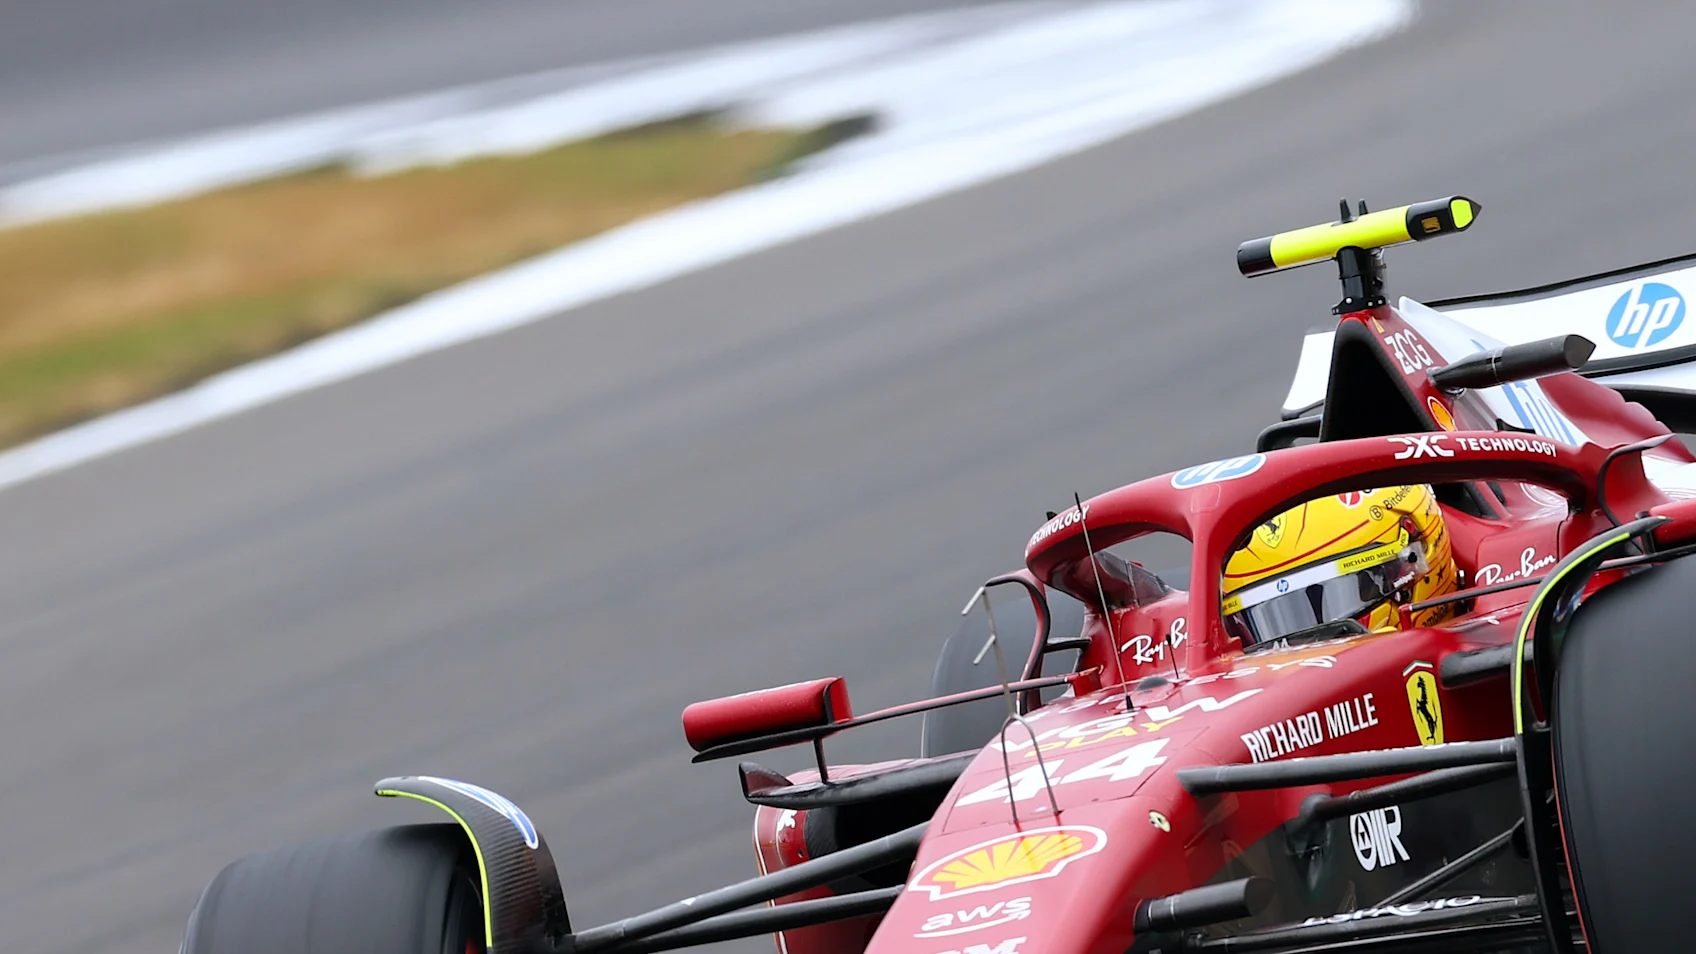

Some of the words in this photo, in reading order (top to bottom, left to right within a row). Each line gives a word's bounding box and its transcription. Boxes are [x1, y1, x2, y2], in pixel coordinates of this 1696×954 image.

[1606, 282, 1686, 348] hp
[1387, 435, 1454, 460] DXC
[1455, 437, 1557, 457] TECHNOLOGY
[1029, 505, 1090, 547] TECHNOLOGY
[1343, 555, 1376, 569] RICHARD
[1121, 617, 1188, 665] Ray-B
[990, 688, 1264, 753] VGW
[1024, 716, 1185, 758] PLAY
[1241, 711, 1324, 763] RICHARD
[1324, 693, 1379, 739] MILLE
[954, 738, 1170, 807] 44
[918, 897, 1032, 934] aws
